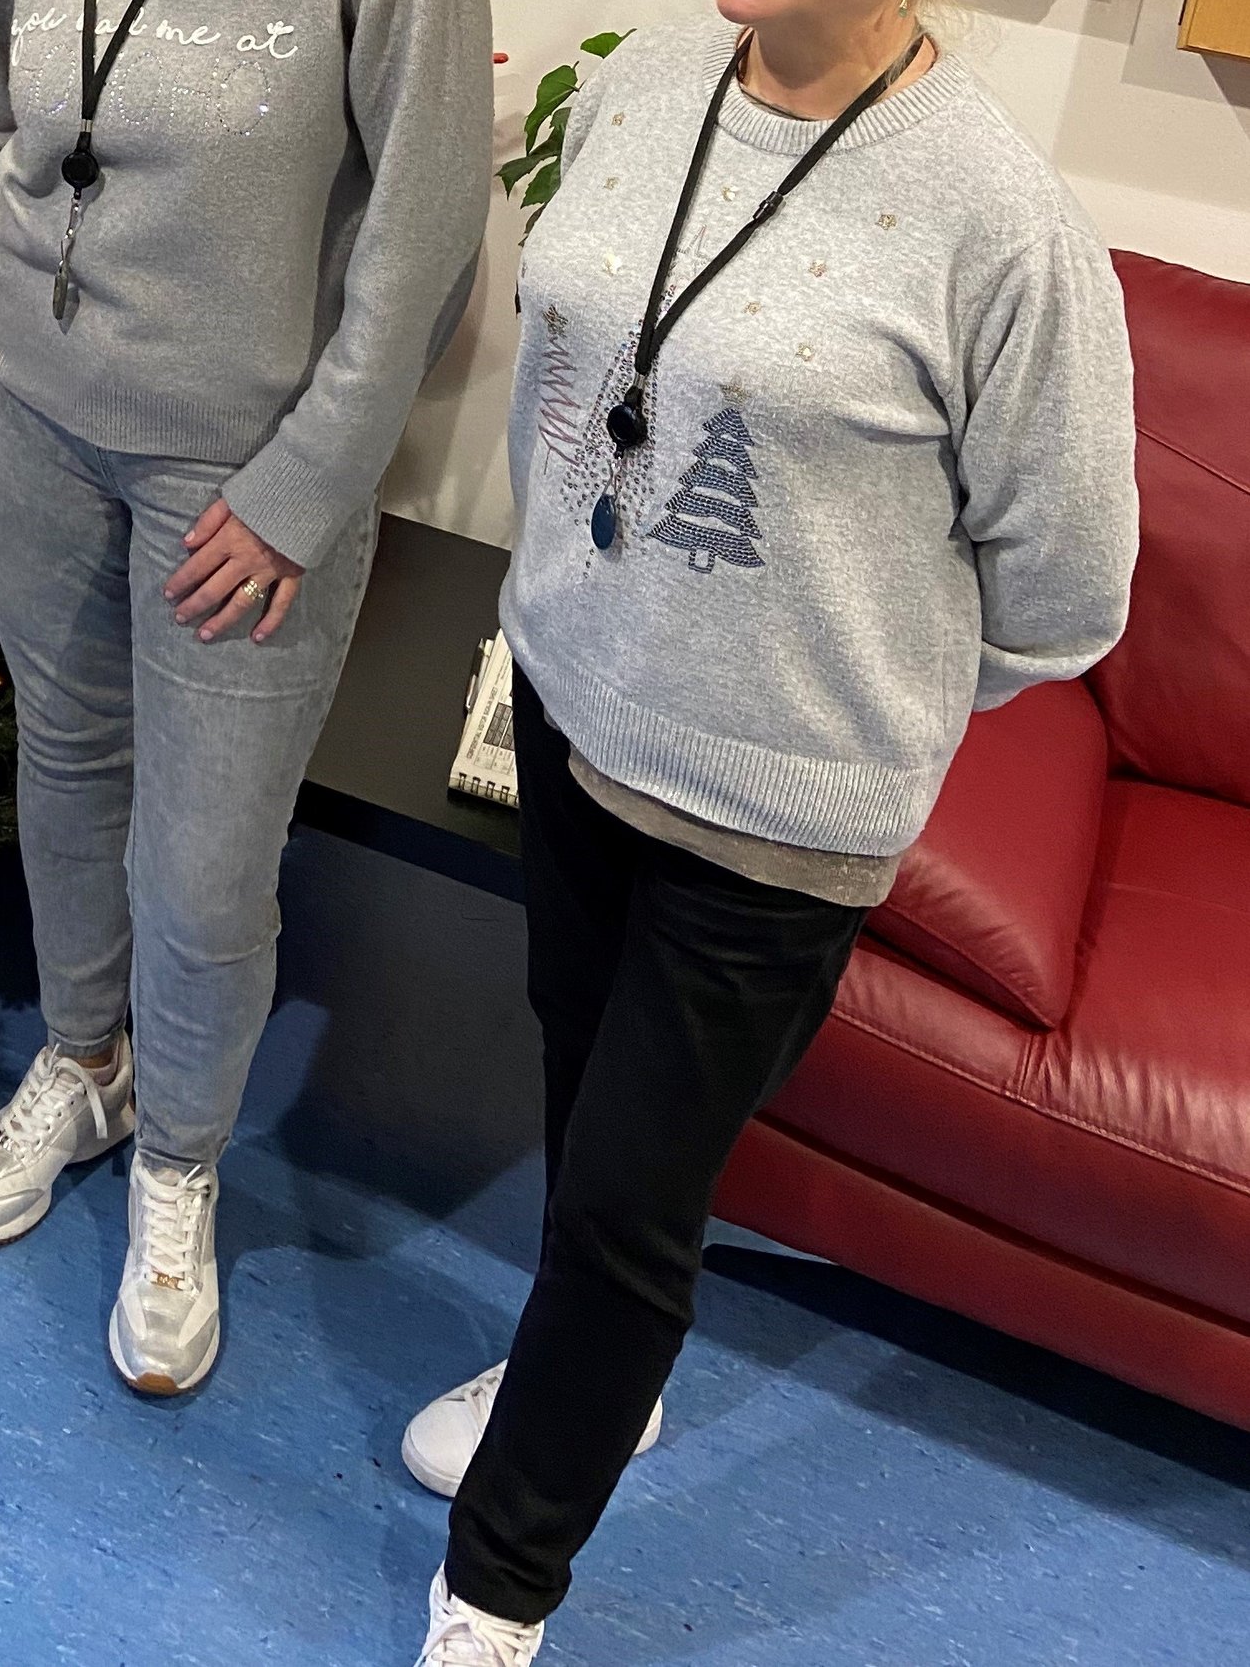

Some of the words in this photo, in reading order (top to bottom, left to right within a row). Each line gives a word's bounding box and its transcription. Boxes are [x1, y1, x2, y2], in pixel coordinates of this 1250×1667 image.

[11, 8, 67, 66] you
[156, 19, 221, 45] me
[236, 20, 298, 59] at
